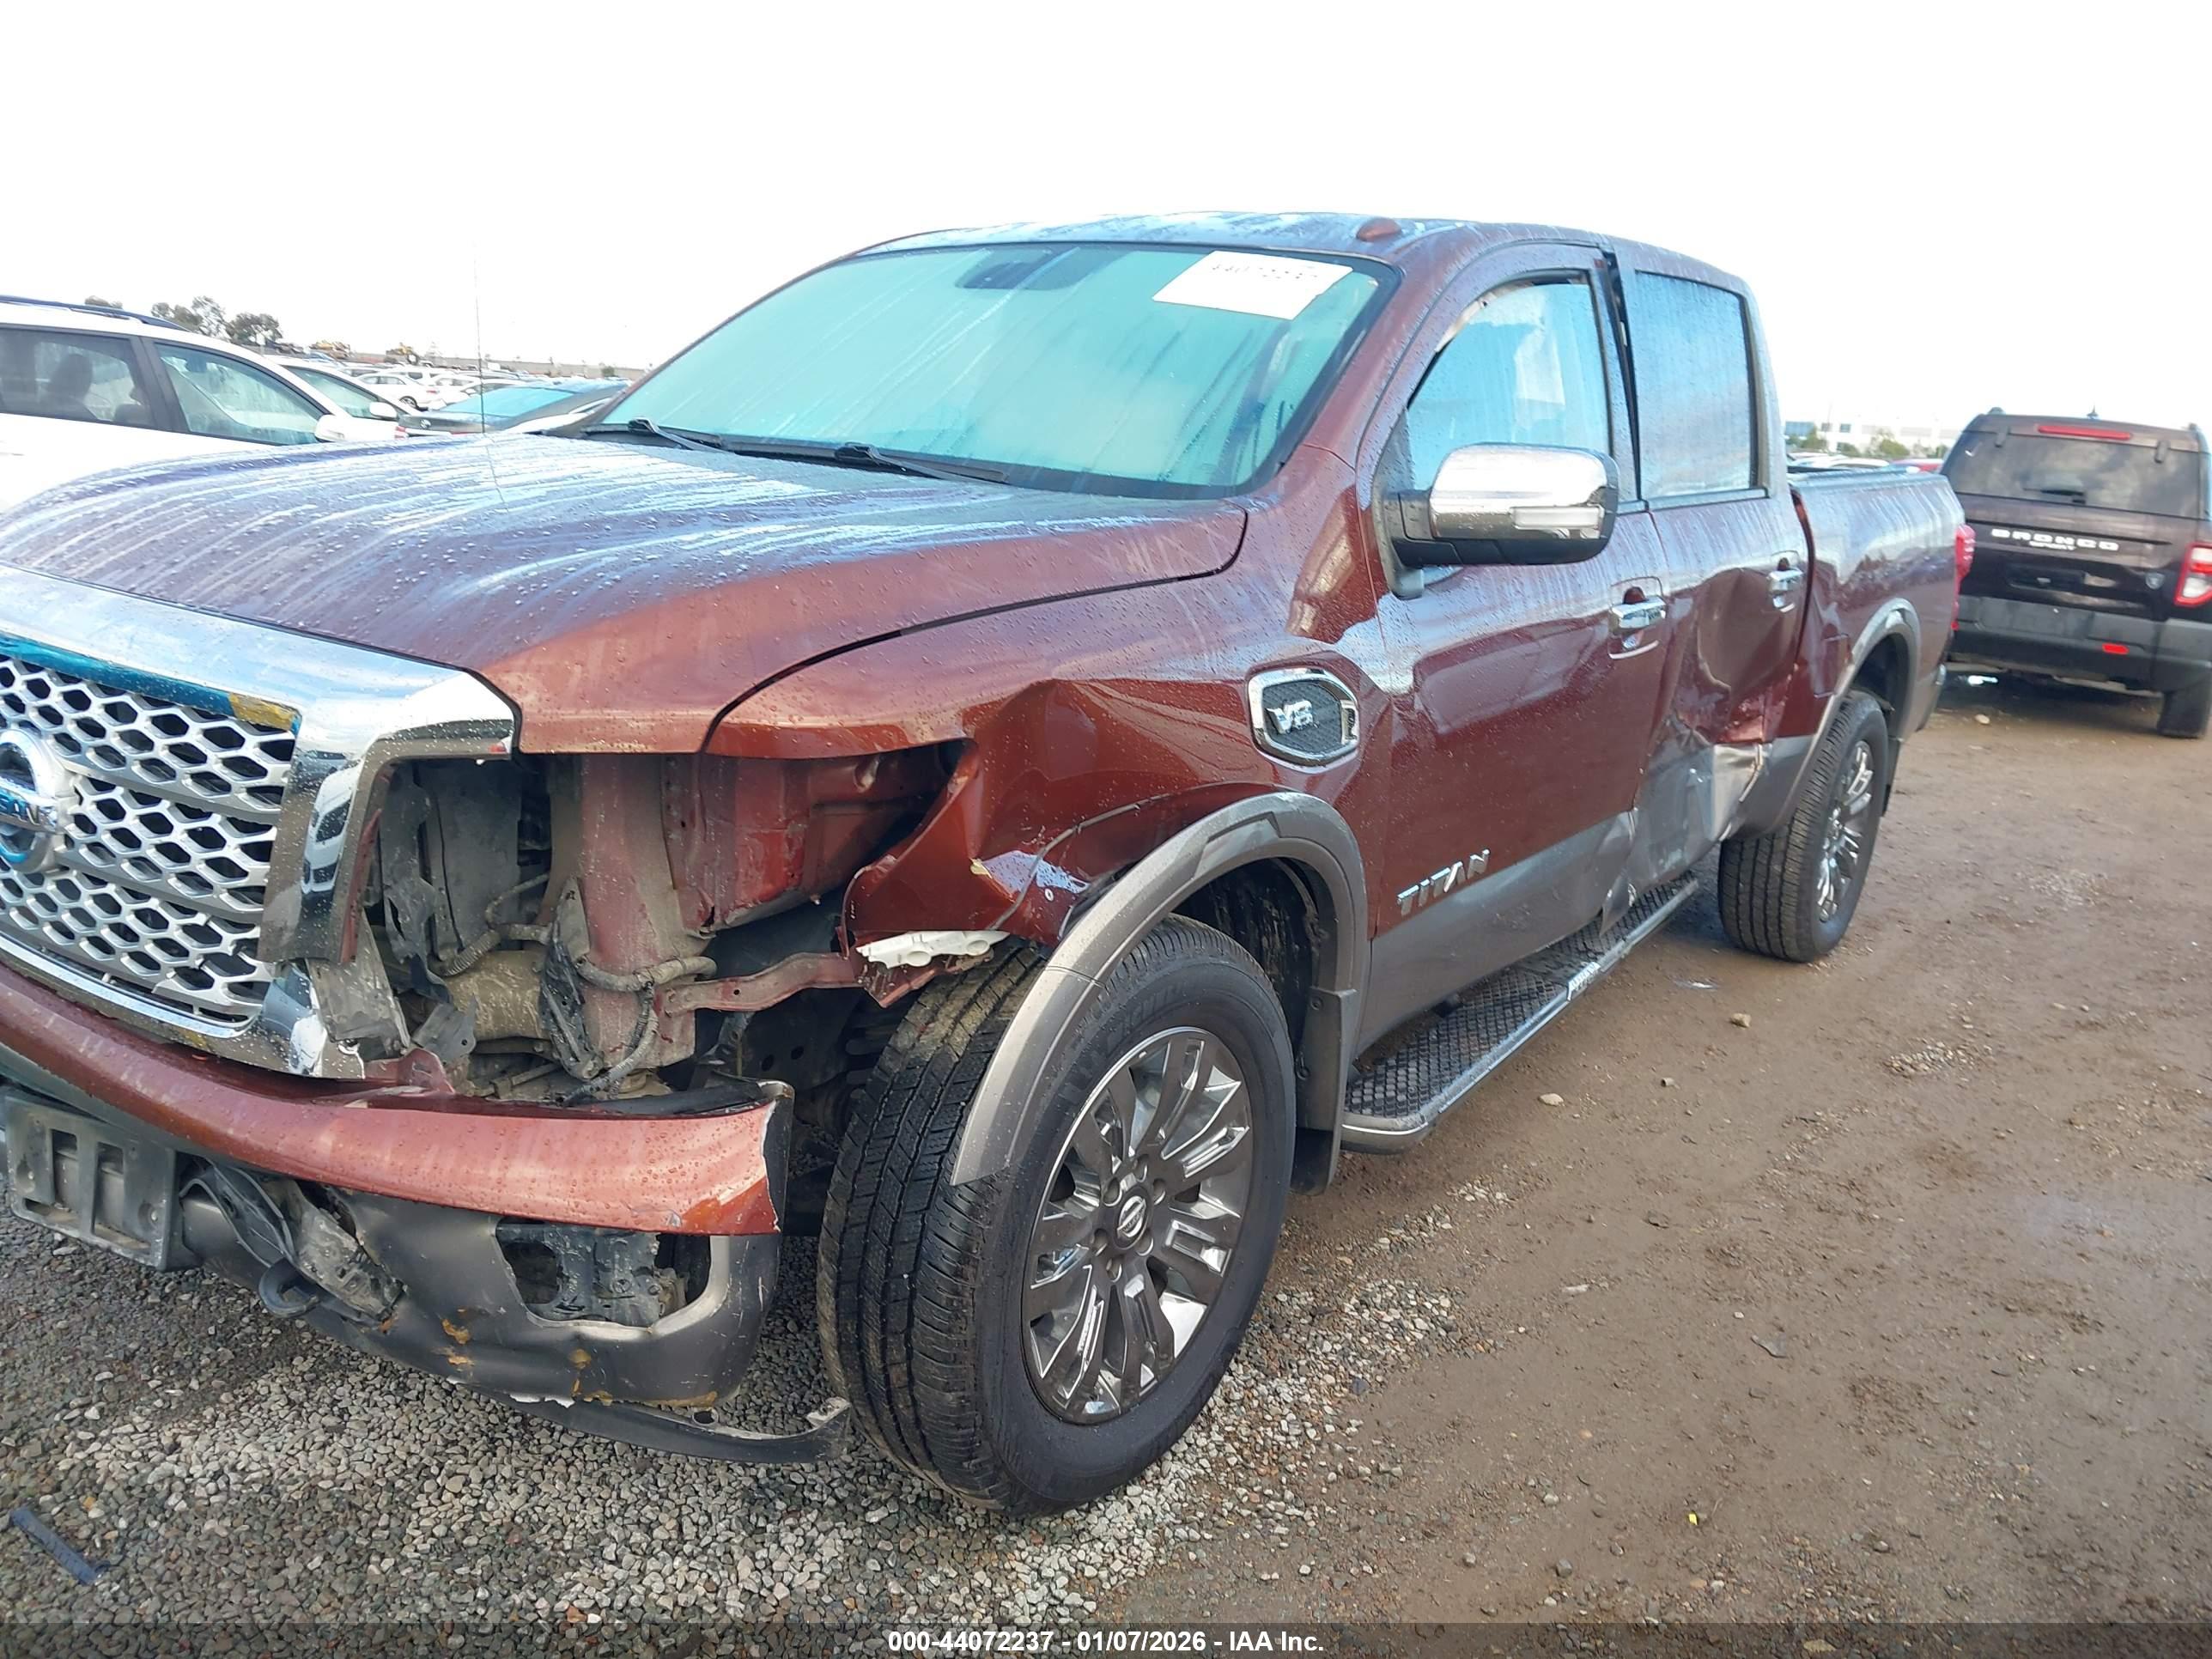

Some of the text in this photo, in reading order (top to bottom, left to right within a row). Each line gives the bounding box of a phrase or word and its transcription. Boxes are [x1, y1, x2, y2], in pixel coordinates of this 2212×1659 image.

[1990, 528, 2119, 551] BRONCO
[1266, 698, 1313, 734] V8
[1396, 848, 1491, 917] TITAN
